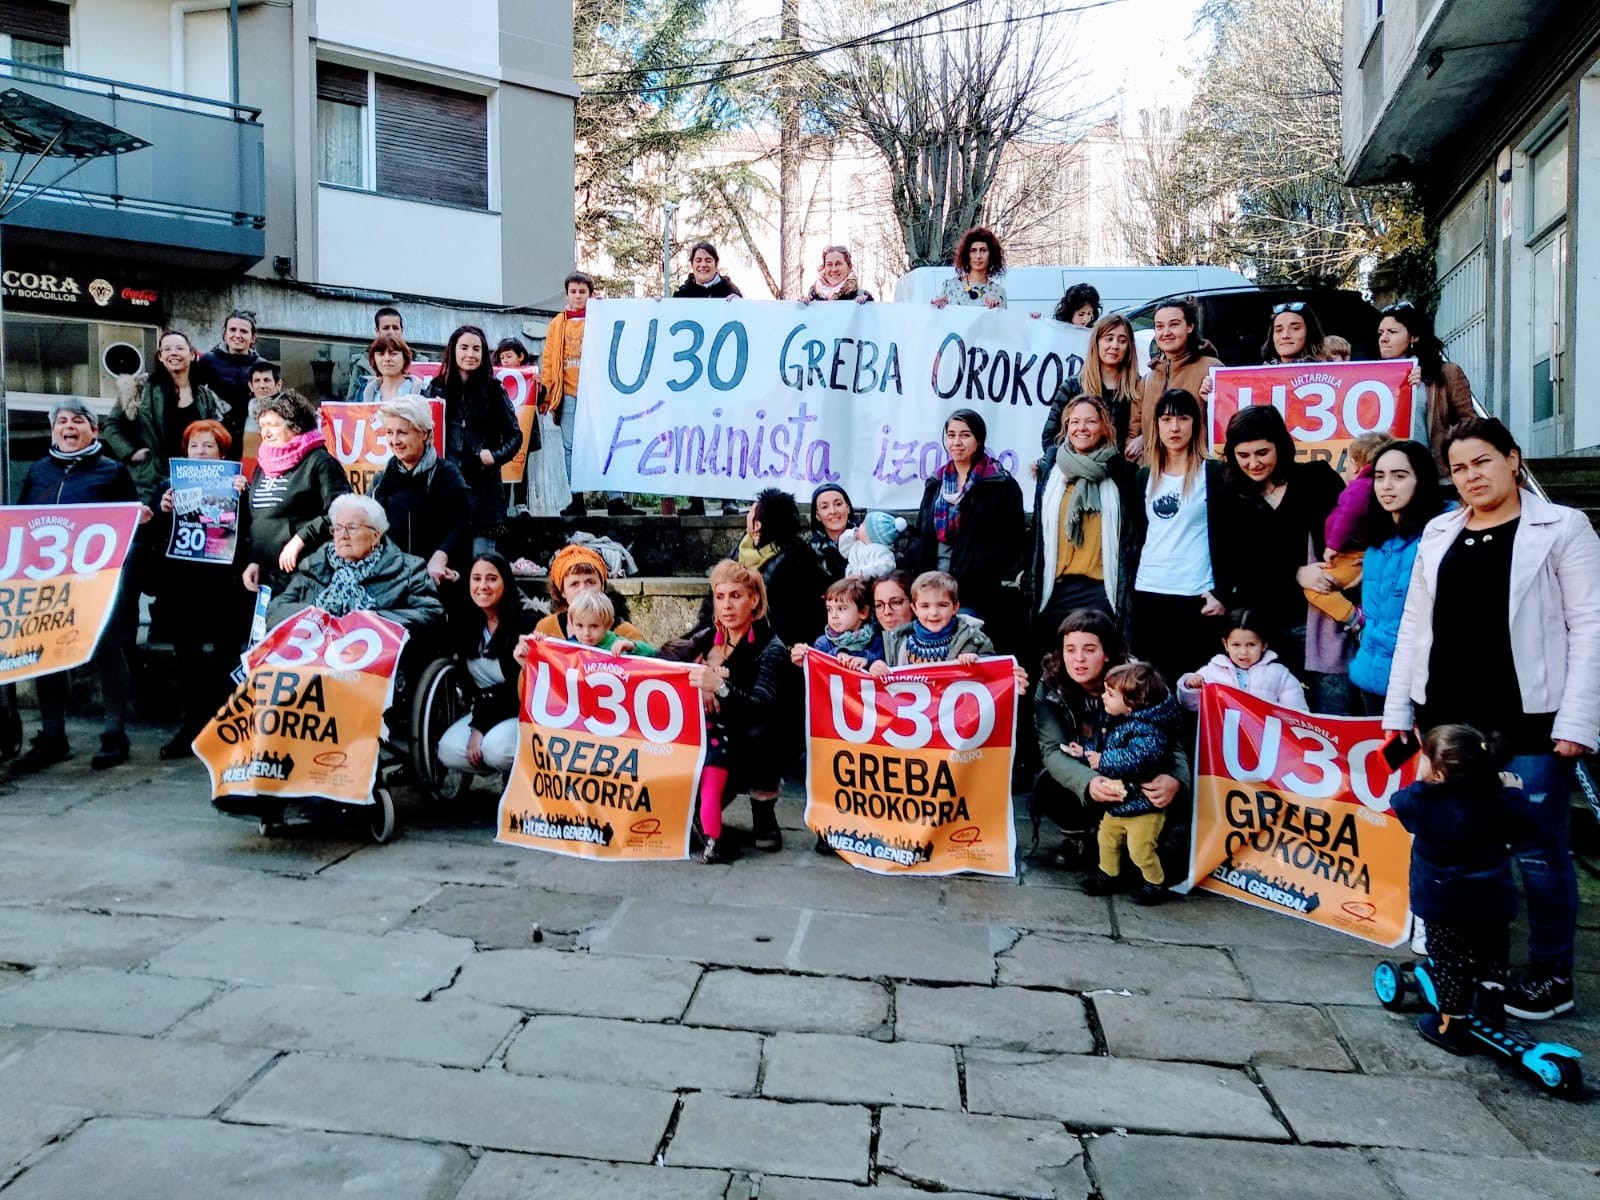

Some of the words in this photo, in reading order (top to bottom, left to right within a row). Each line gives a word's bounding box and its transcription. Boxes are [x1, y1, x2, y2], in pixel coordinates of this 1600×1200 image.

[2, 270, 82, 295] CORA
[9, 288, 16, 296] Y
[18, 289, 77, 303] BOCADILLOS
[131, 298, 149, 306] zero
[779, 323, 904, 395] GREBA
[1290, 373, 1342, 389] URTARRILA
[333, 418, 395, 466] U3
[602, 400, 841, 486] Feminista
[28, 515, 76, 531] URTARRILA
[175, 527, 206, 551] 30
[0, 582, 70, 617] REBA
[0, 608, 75, 640] OKORRA
[265, 619, 384, 672] 30
[583, 662, 631, 684] URTARRILA
[531, 660, 685, 744] U30
[829, 674, 996, 751] U30
[531, 732, 640, 783] GREBA
[641, 742, 674, 756] ENERO
[949, 749, 984, 764] ENERO
[832, 749, 958, 799] GREBA
[532, 772, 653, 813] OROKORRA
[834, 788, 970, 828] OROKORRA
[522, 820, 563, 840] HUELGA
[562, 825, 607, 846] GENERAL
[1225, 789, 1360, 858] GREBA
[826, 833, 872, 858] HUELGA
[874, 845, 927, 867] GENERAL
[1212, 865, 1247, 890] ELGA
[1246, 878, 1309, 914] GENERAL
